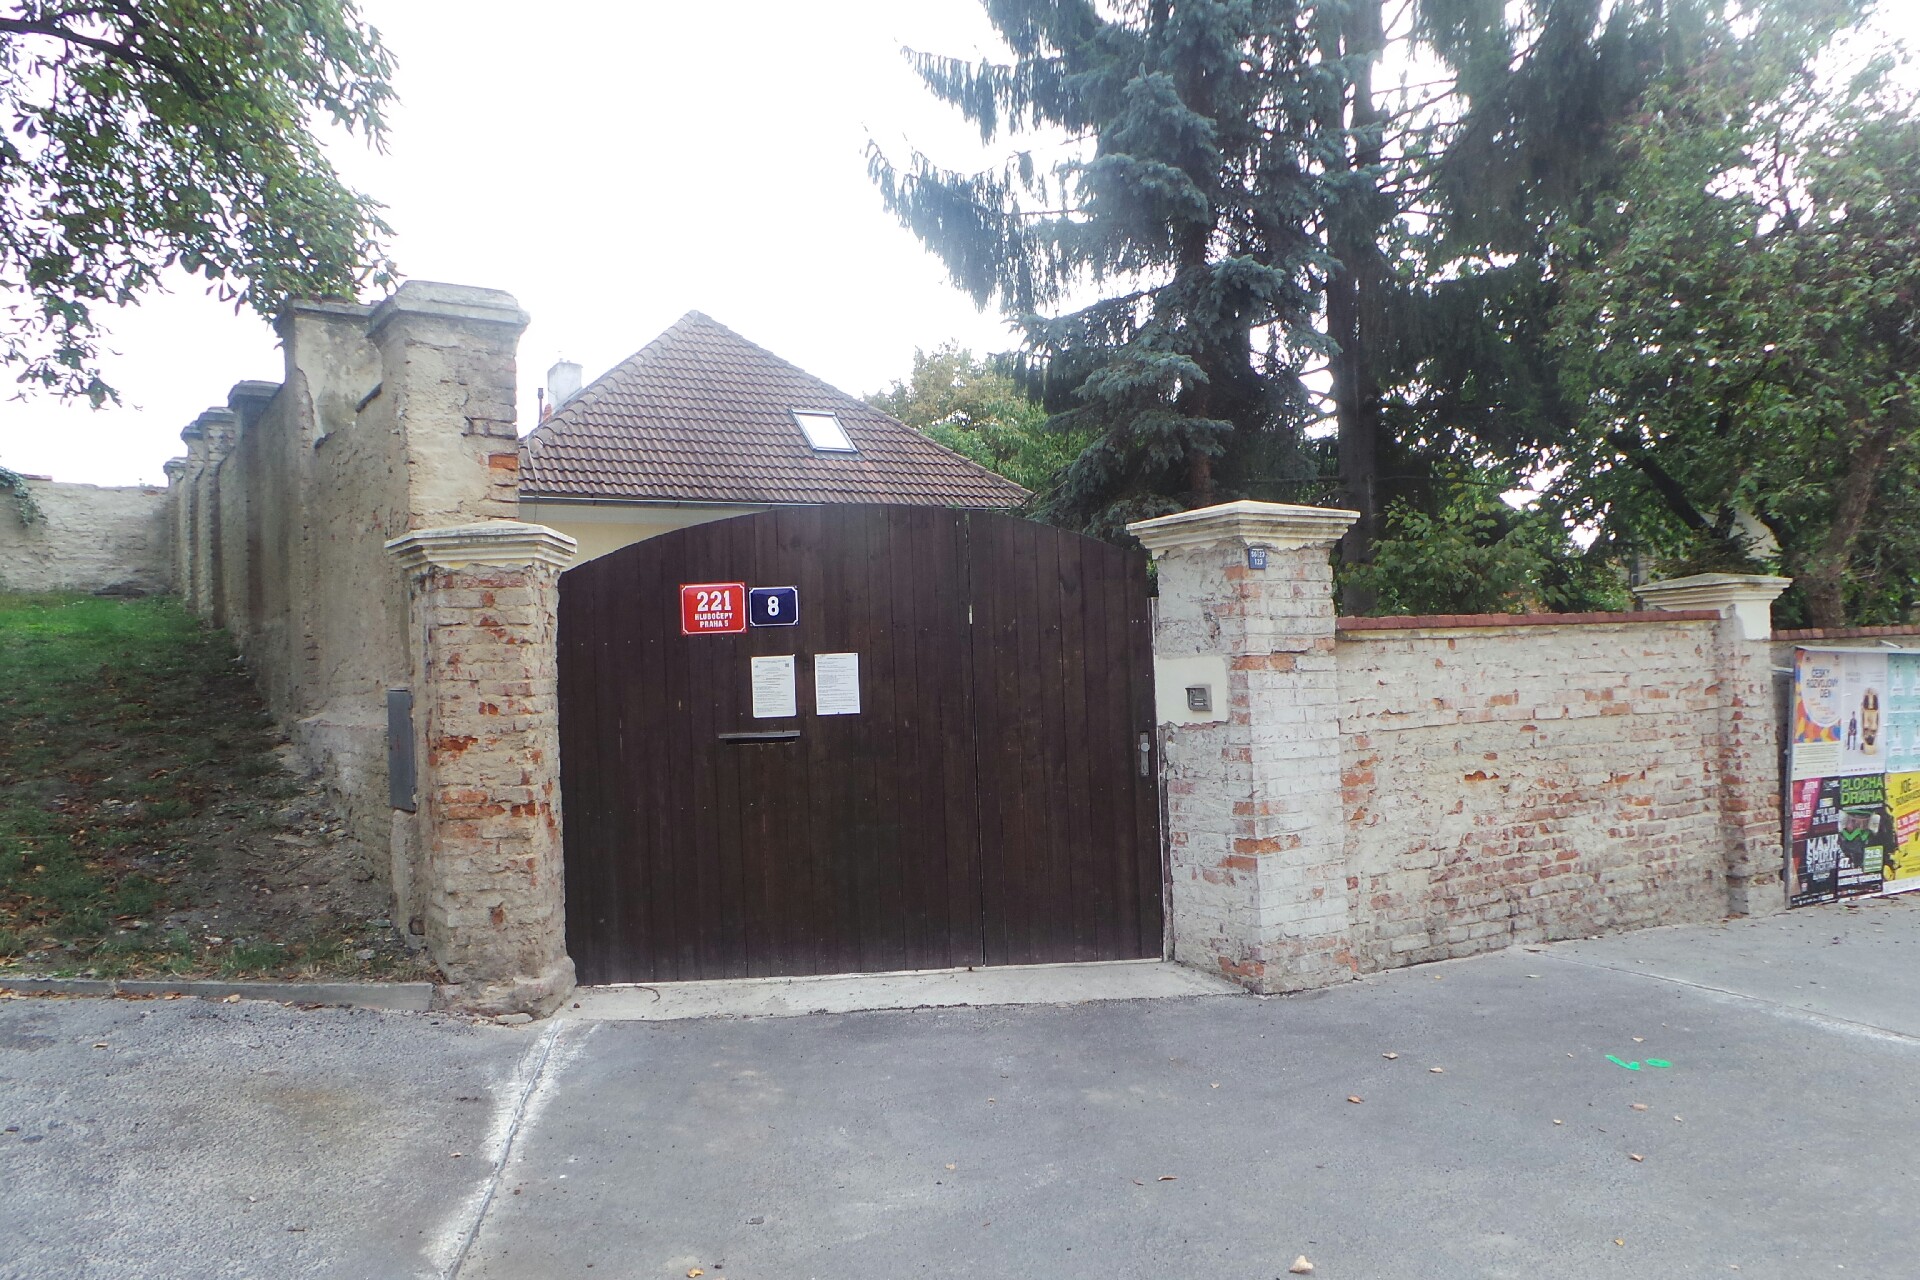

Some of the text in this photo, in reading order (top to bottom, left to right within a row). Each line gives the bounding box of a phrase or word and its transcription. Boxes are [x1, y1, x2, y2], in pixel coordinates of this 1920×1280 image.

[696, 590, 732, 611] 221
[768, 596, 780, 616] 8
[694, 612, 733, 621] HLUBOČEPY
[700, 619, 729, 628] PRAHA 5
